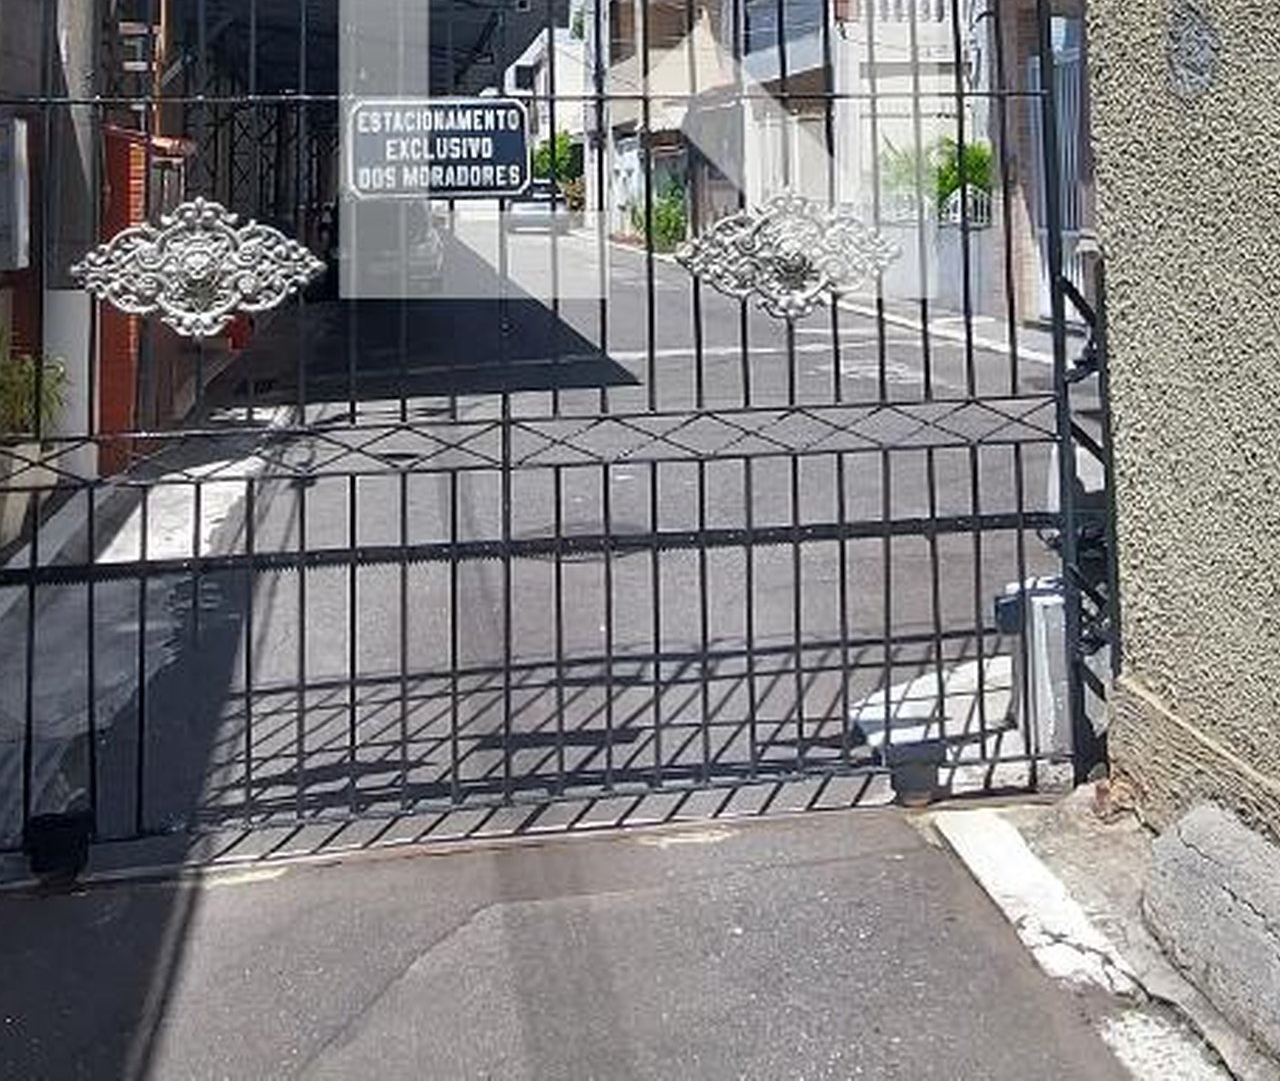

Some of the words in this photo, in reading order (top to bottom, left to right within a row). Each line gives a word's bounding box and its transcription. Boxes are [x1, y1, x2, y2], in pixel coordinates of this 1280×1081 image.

[357, 108, 520, 133] ESTACIONAMENTO
[385, 137, 493, 160] EXCLUSIVO
[358, 168, 396, 189] DOS
[402, 165, 520, 188] MORADORES
